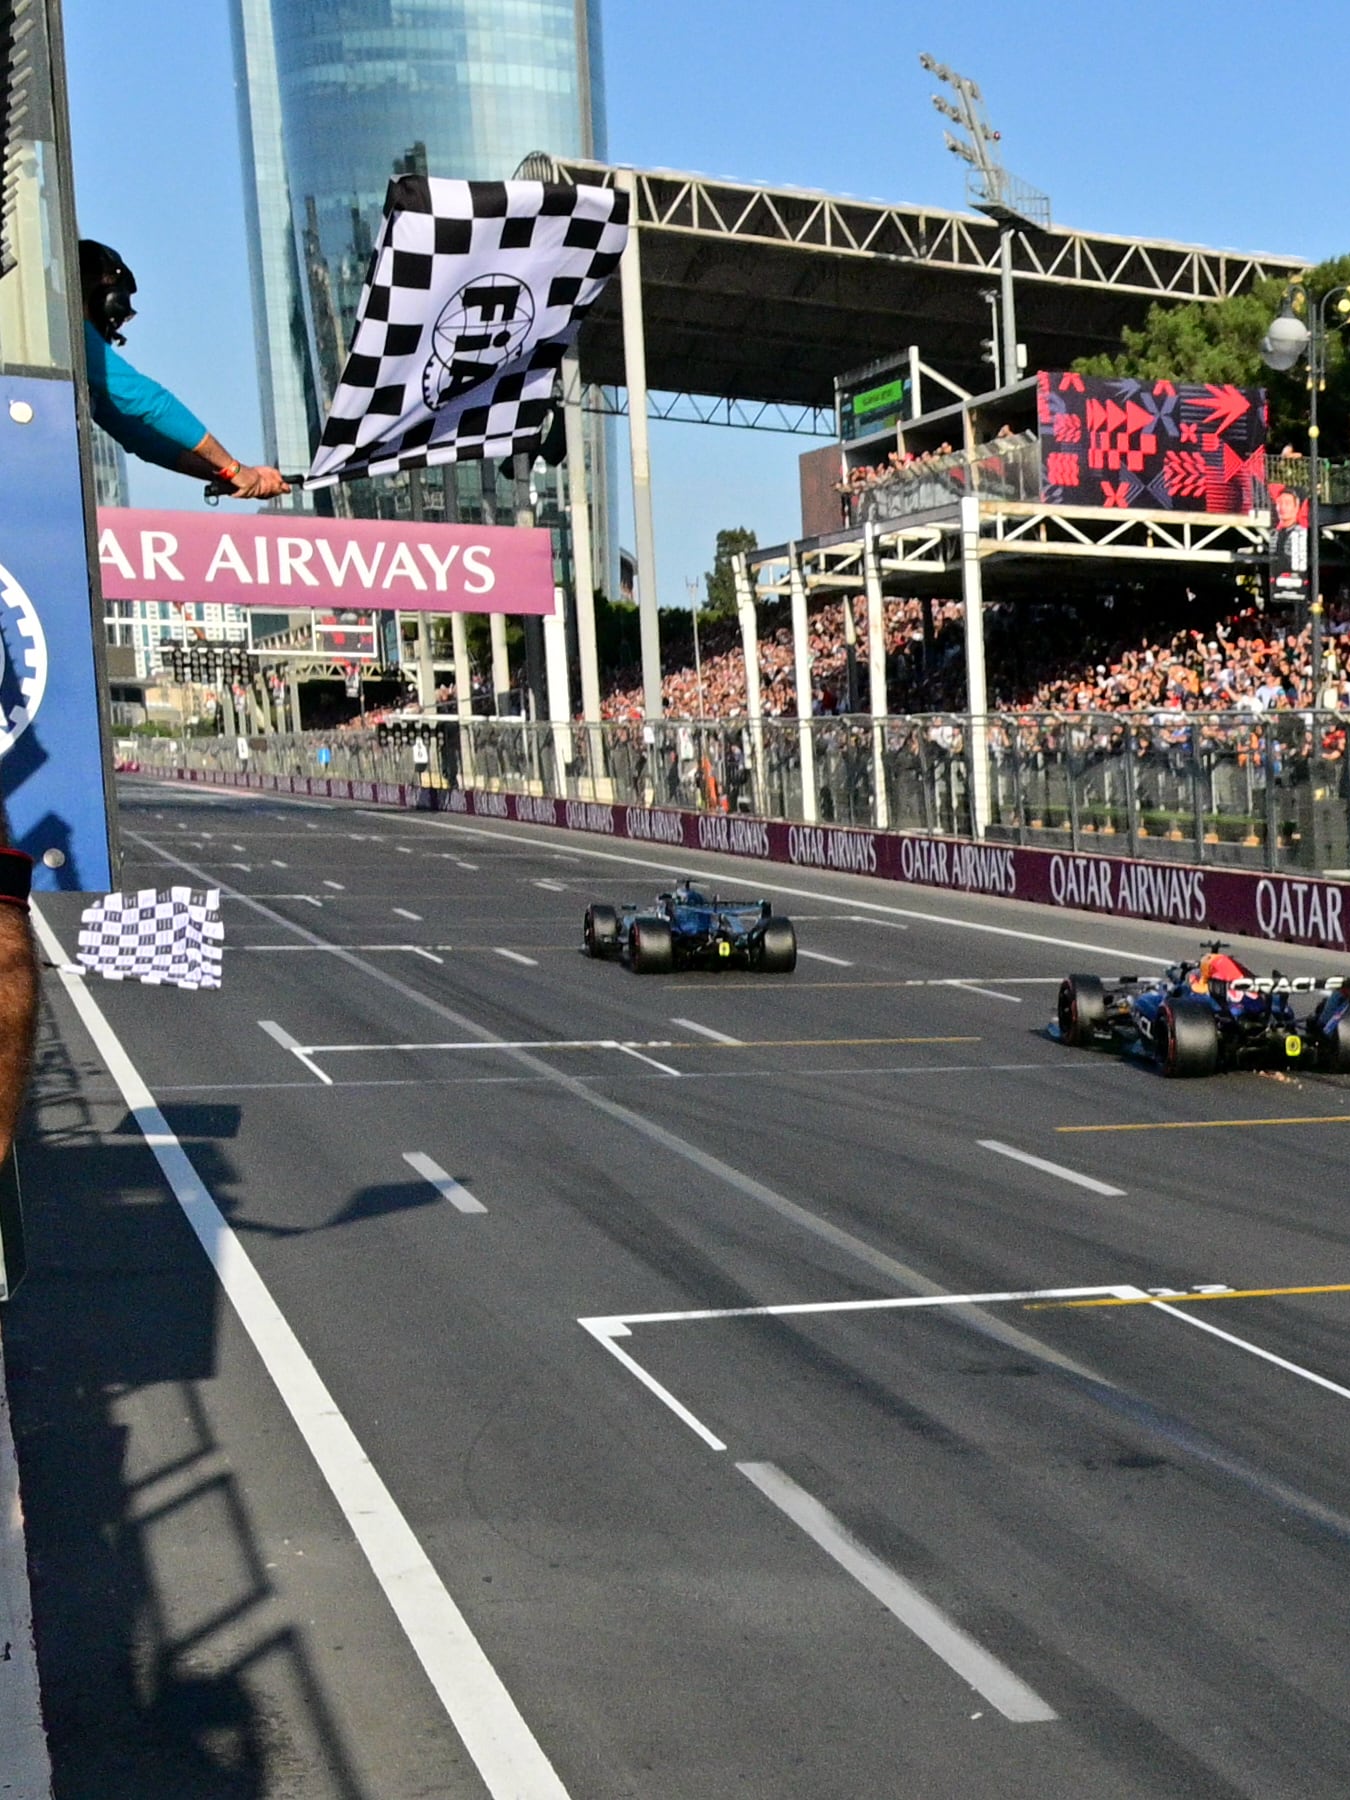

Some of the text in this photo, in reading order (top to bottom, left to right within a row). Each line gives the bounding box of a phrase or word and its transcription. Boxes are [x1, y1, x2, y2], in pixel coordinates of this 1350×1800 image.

[205, 534, 496, 594] AIRWAYS
[788, 826, 877, 872] QATAR AIRWAYS
[901, 838, 1016, 894] QATAR AIRWAYS
[1050, 855, 1206, 922] QATAR AIRWAYS
[1255, 879, 1344, 943] QATAR
